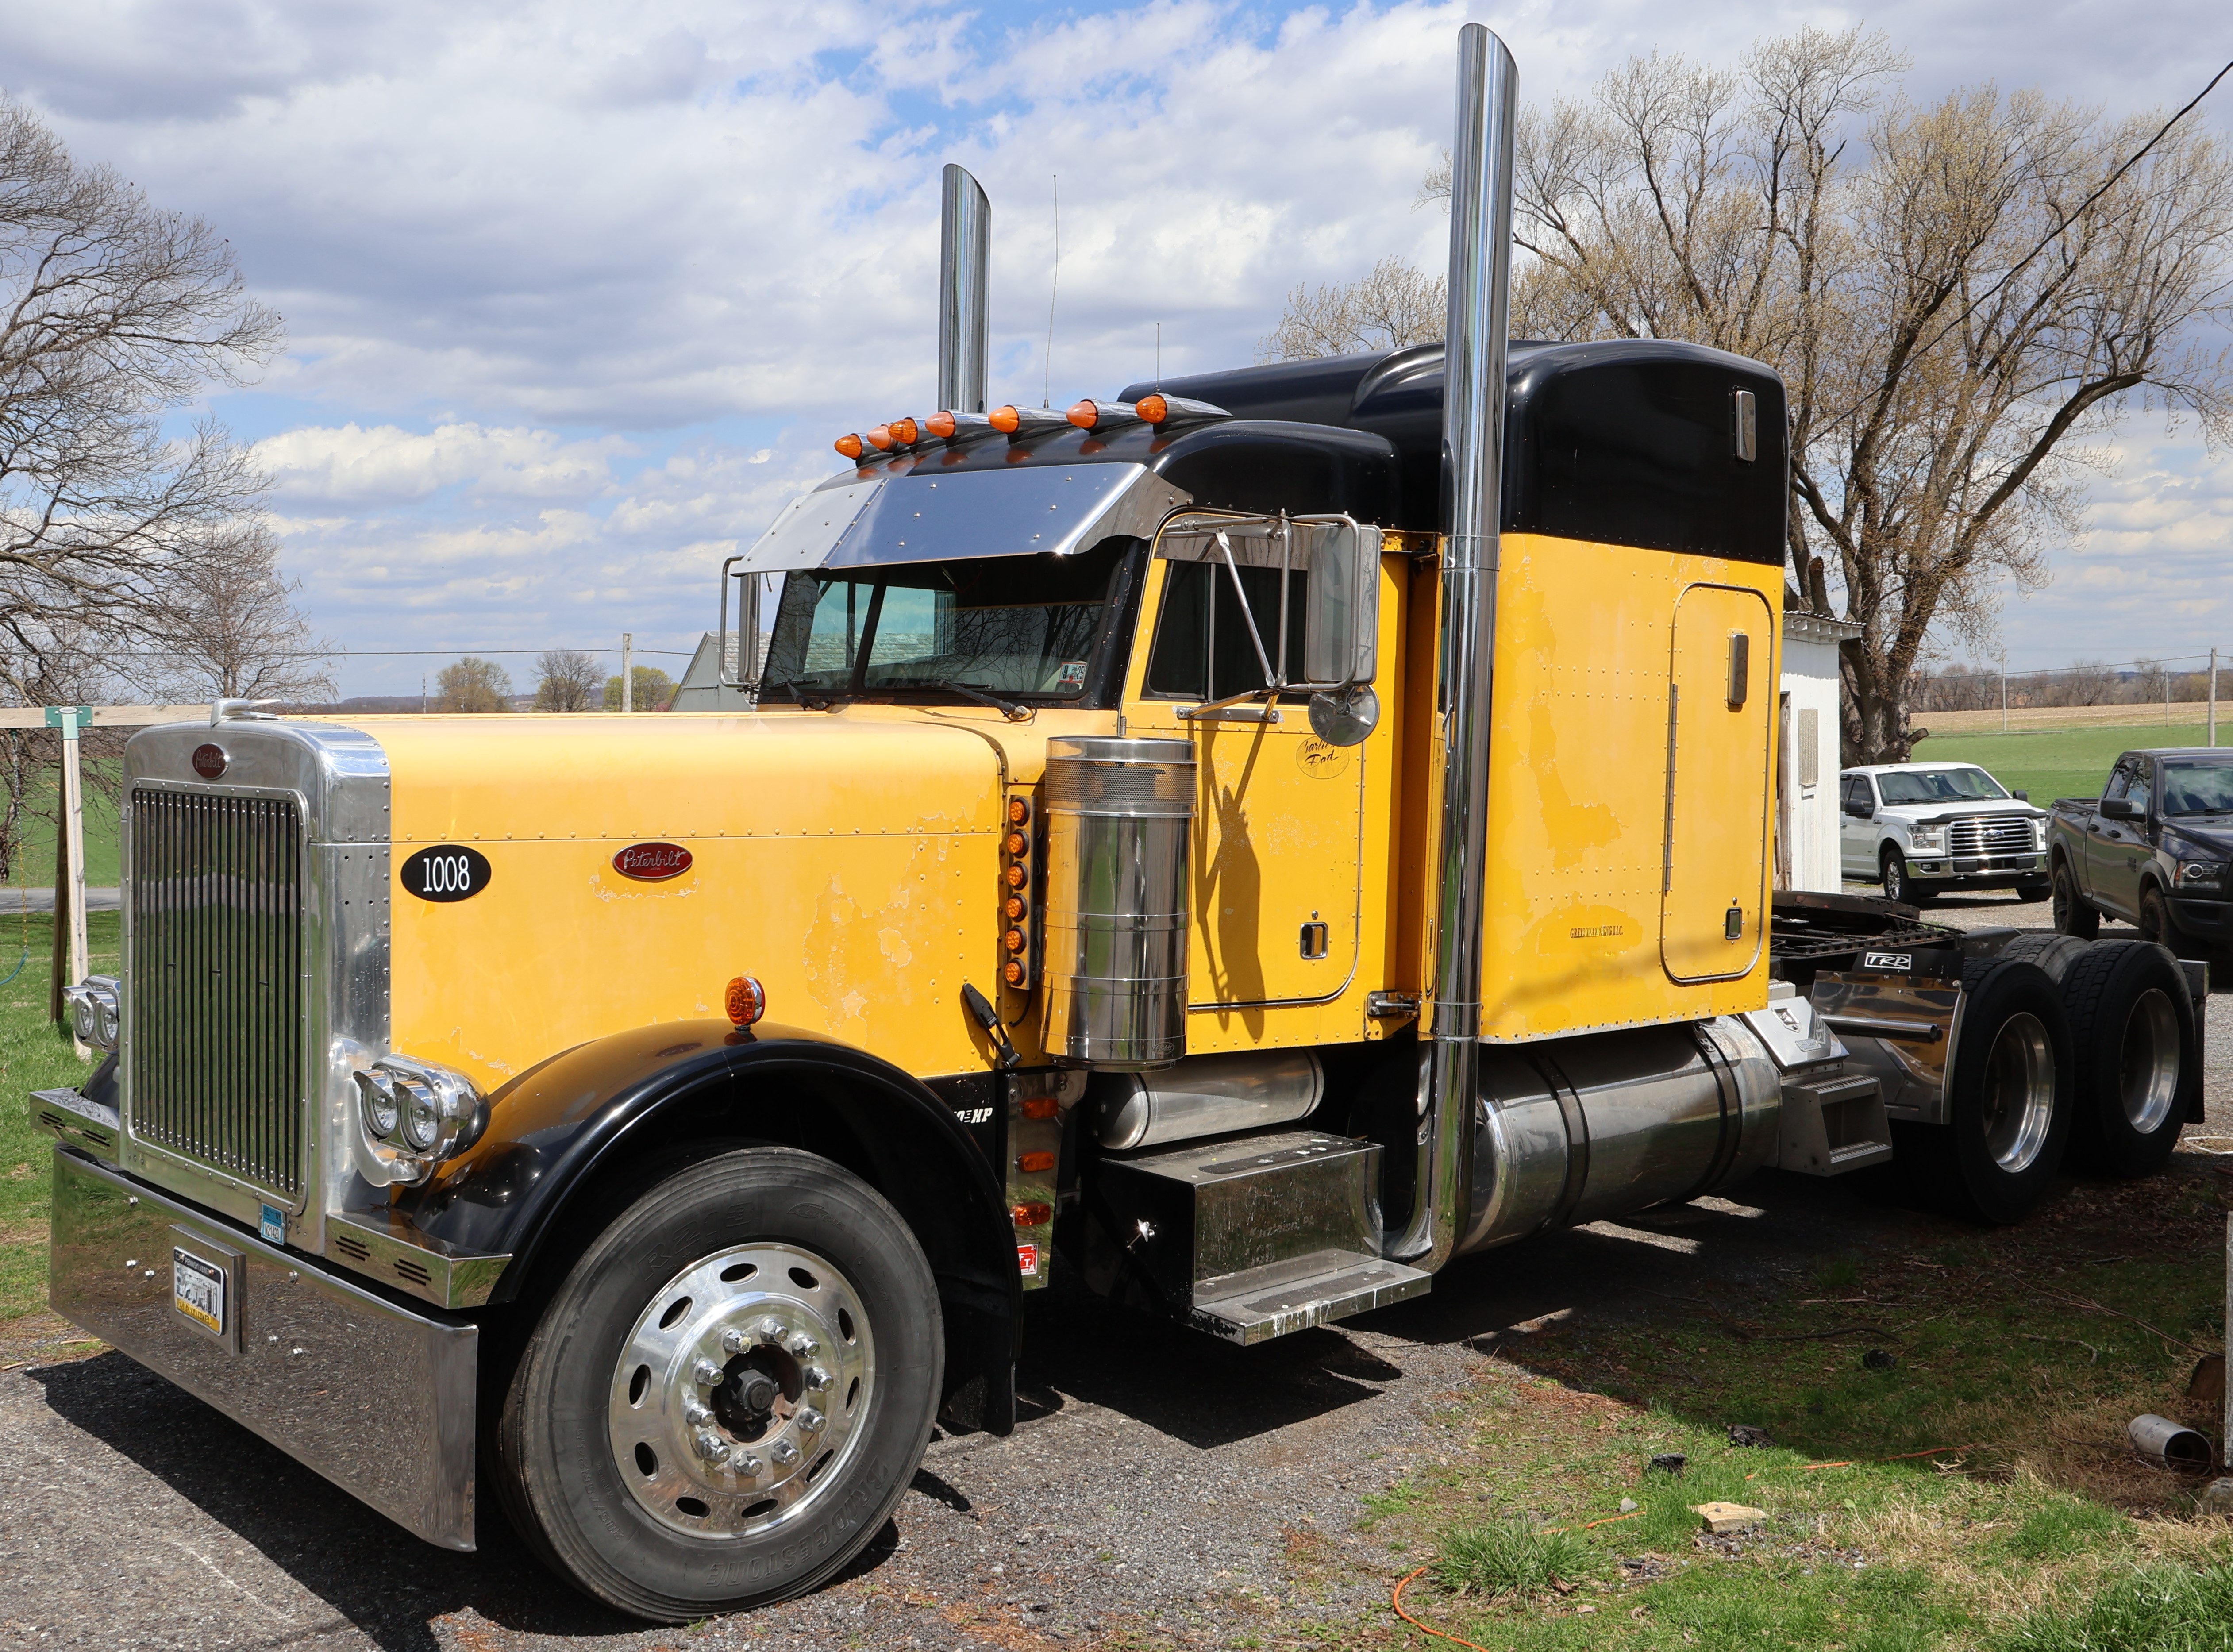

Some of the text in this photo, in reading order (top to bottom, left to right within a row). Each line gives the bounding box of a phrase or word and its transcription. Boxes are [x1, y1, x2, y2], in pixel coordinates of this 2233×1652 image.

[1063, 665, 1069, 679] 9
[1076, 666, 1084, 680] 25
[1305, 749, 1341, 767] Dad
[623, 849, 686, 870] Peterbilt
[423, 855, 470, 892] 1008
[1867, 955, 1910, 968] TRP
[970, 1107, 993, 1124] HP
[705, 1455, 889, 1588] BRIDGESTONE
